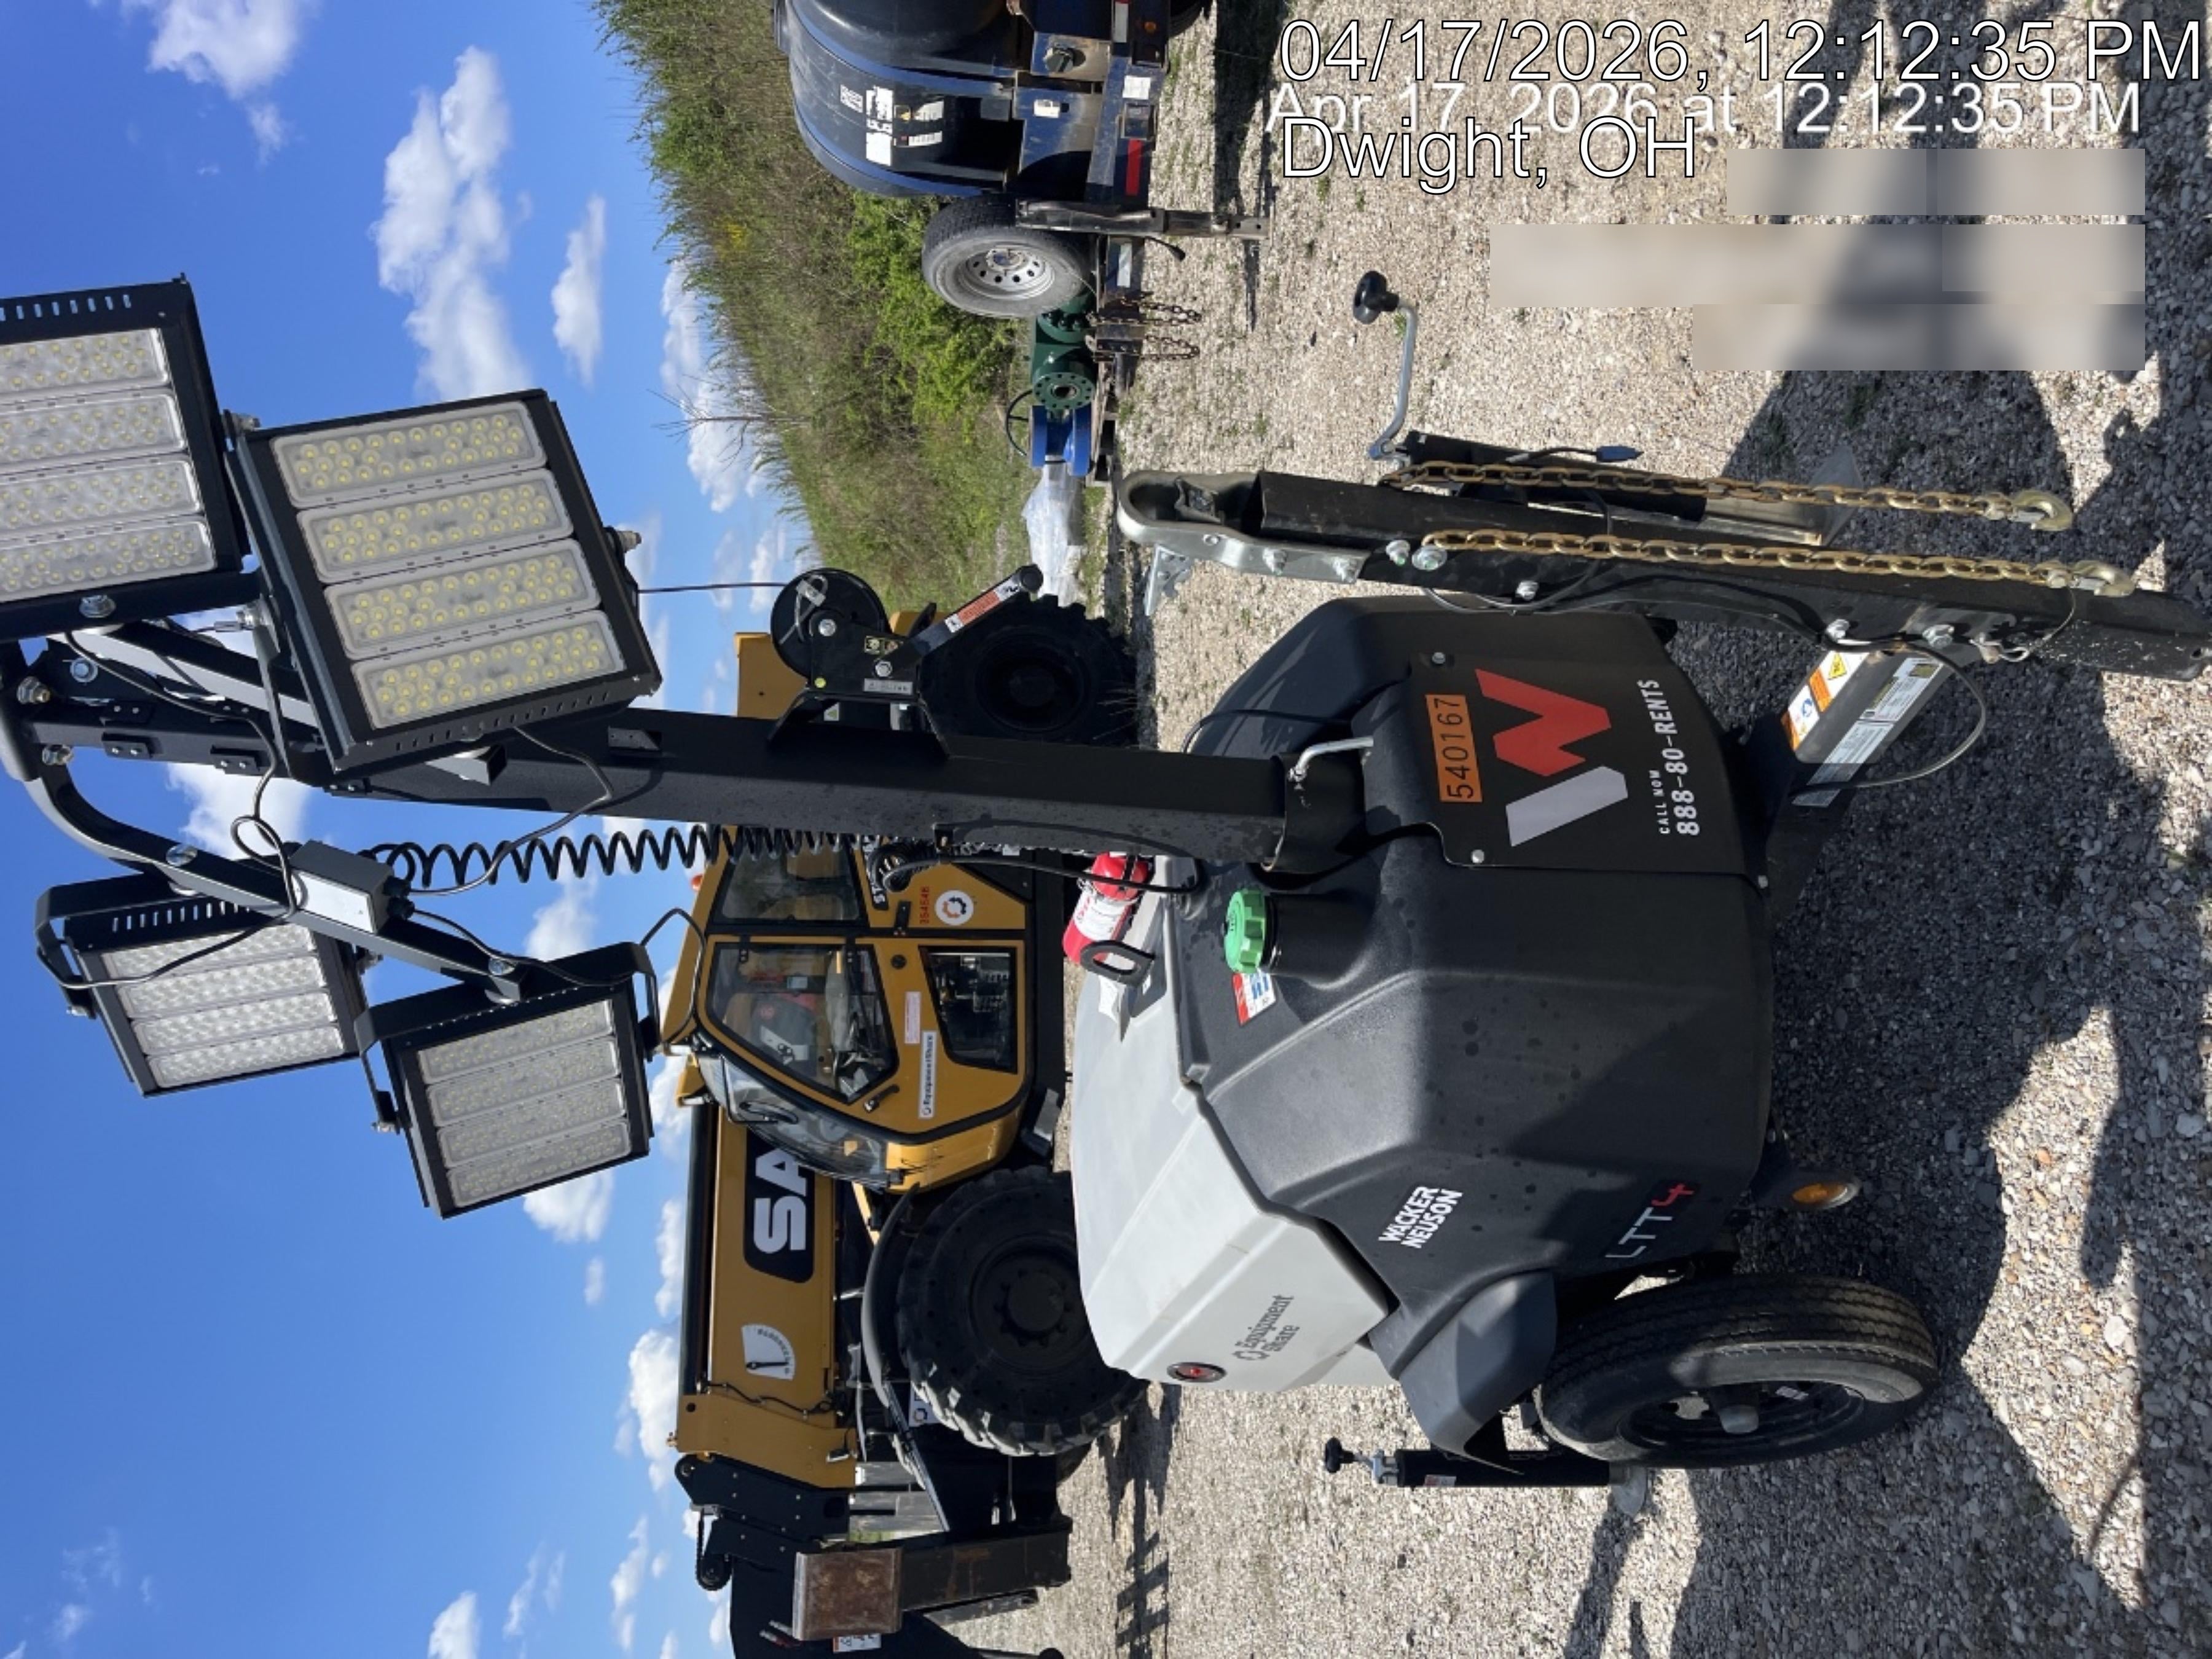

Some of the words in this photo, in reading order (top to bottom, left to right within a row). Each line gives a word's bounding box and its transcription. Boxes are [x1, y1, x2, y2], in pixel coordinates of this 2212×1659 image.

[1433, 697, 1473, 799] 540167
[1636, 680, 1700, 836] 888-80-RENTS
[1649, 769, 1665, 797] NOW
[1655, 802, 1670, 834] CALL
[1378, 1186, 1440, 1241] WACKER
[1400, 1188, 1464, 1249] NEUSON
[1604, 1183, 1695, 1258] LTT4
[1234, 1295, 1294, 1348] Equipment
[1260, 1325, 1300, 1352] Share
